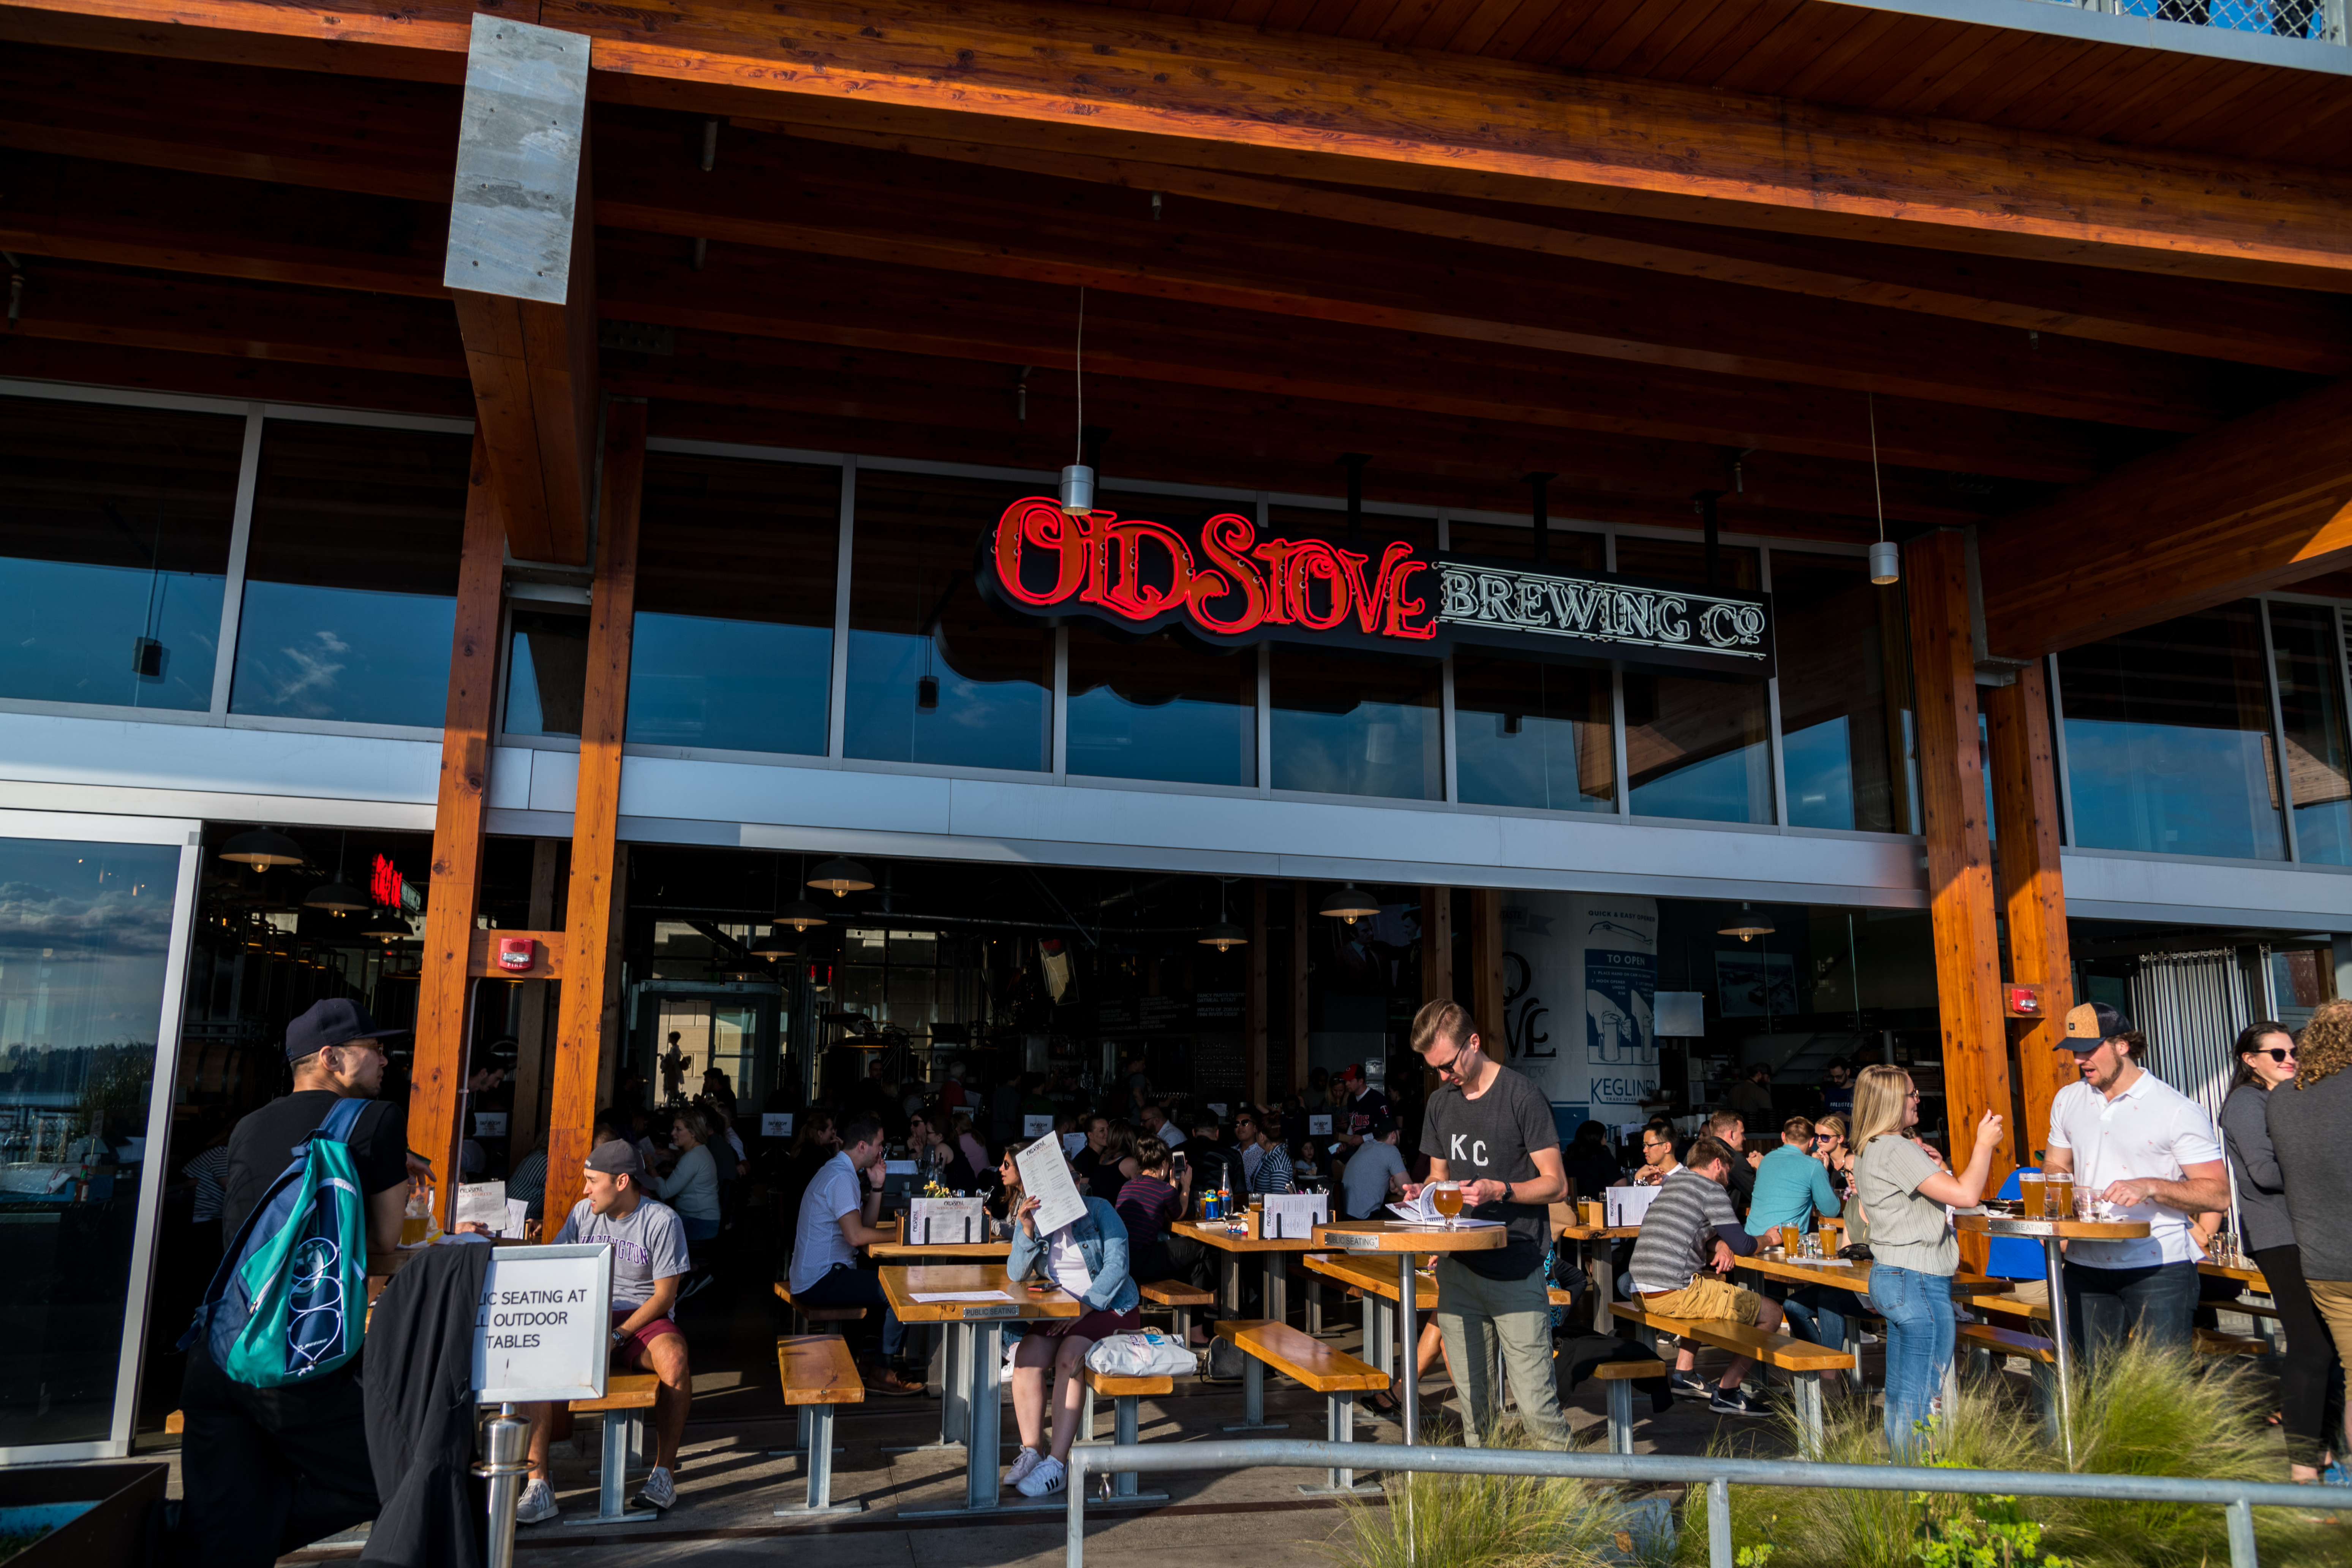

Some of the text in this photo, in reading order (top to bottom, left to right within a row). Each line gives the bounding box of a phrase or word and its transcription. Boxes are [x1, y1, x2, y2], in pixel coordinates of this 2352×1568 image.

[999, 496, 1194, 620] OLD
[1186, 514, 1436, 639] STOVE
[1441, 570, 1690, 640] BREWING
[1607, 954, 1645, 966] TO OPEN
[1991, 1222, 2048, 1232] PUBLIC SEATING
[1327, 1235, 1374, 1246] PUBLIC SEATING
[501, 1290, 563, 1305] SEATING
[567, 1289, 587, 1303] AT
[493, 1312, 568, 1327] OUTDOOR
[305, 1338, 328, 1348] BOEING
[485, 1334, 540, 1349] TABLES
